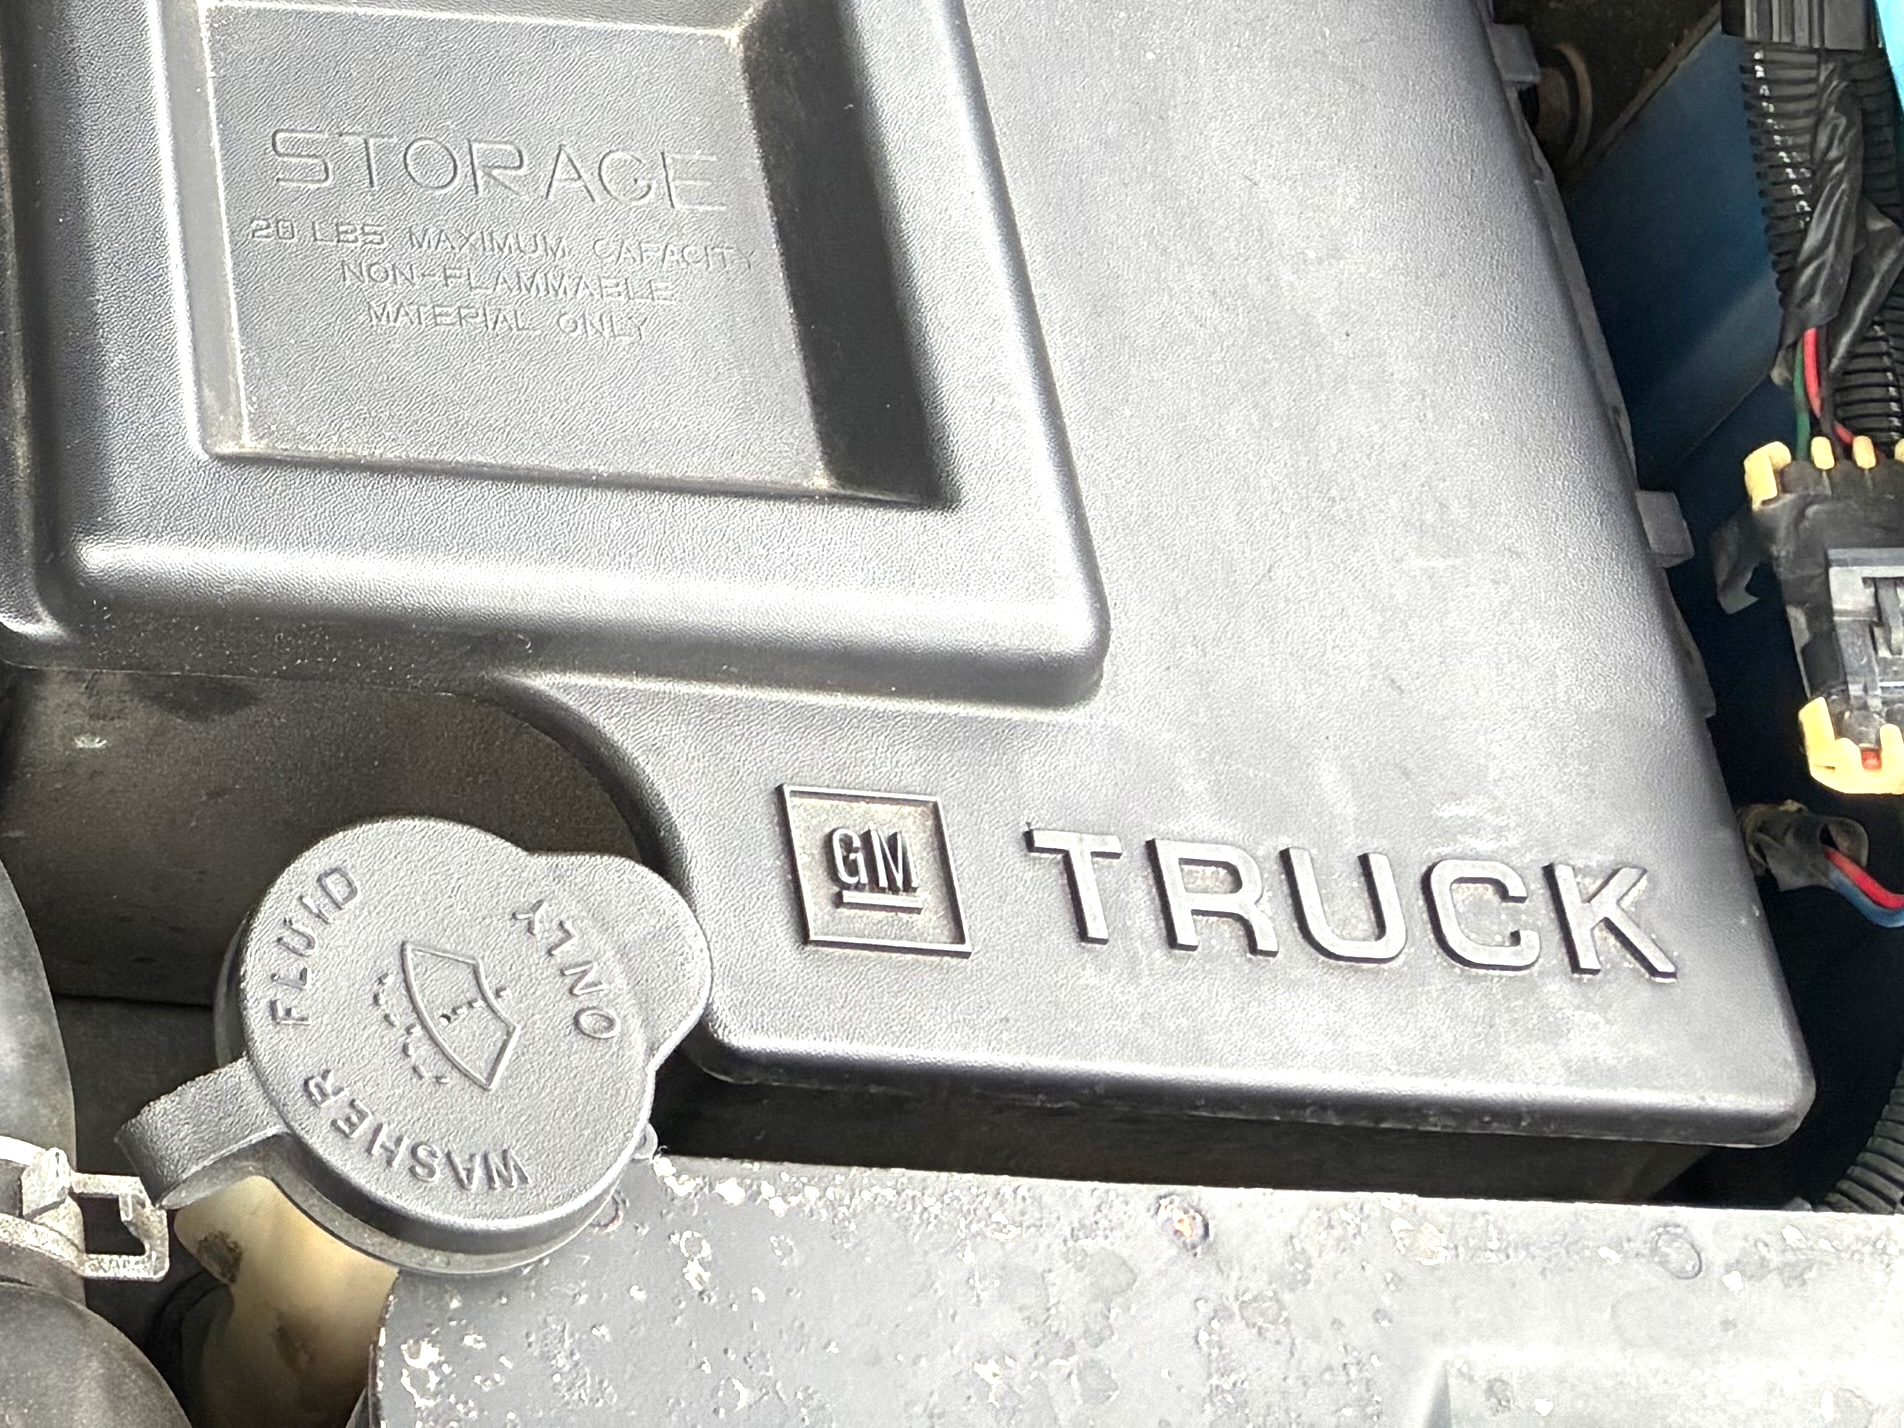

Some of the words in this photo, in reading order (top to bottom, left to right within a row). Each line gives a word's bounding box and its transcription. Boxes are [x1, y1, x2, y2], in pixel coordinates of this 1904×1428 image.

[272, 127, 727, 211] STORAGE
[311, 220, 386, 246] LBS
[409, 227, 570, 261] MAXIMUM
[591, 237, 754, 271] CAPACITY
[341, 258, 677, 304] NON-FLAMMABLE
[369, 300, 542, 336] MATERIAL
[557, 311, 651, 342] ONLY
[269, 868, 360, 1029] FLUID
[829, 823, 915, 896] GM
[1025, 822, 1680, 982] TRUCK
[510, 899, 622, 1041] ONLY
[300, 1069, 531, 1191] WASHER
